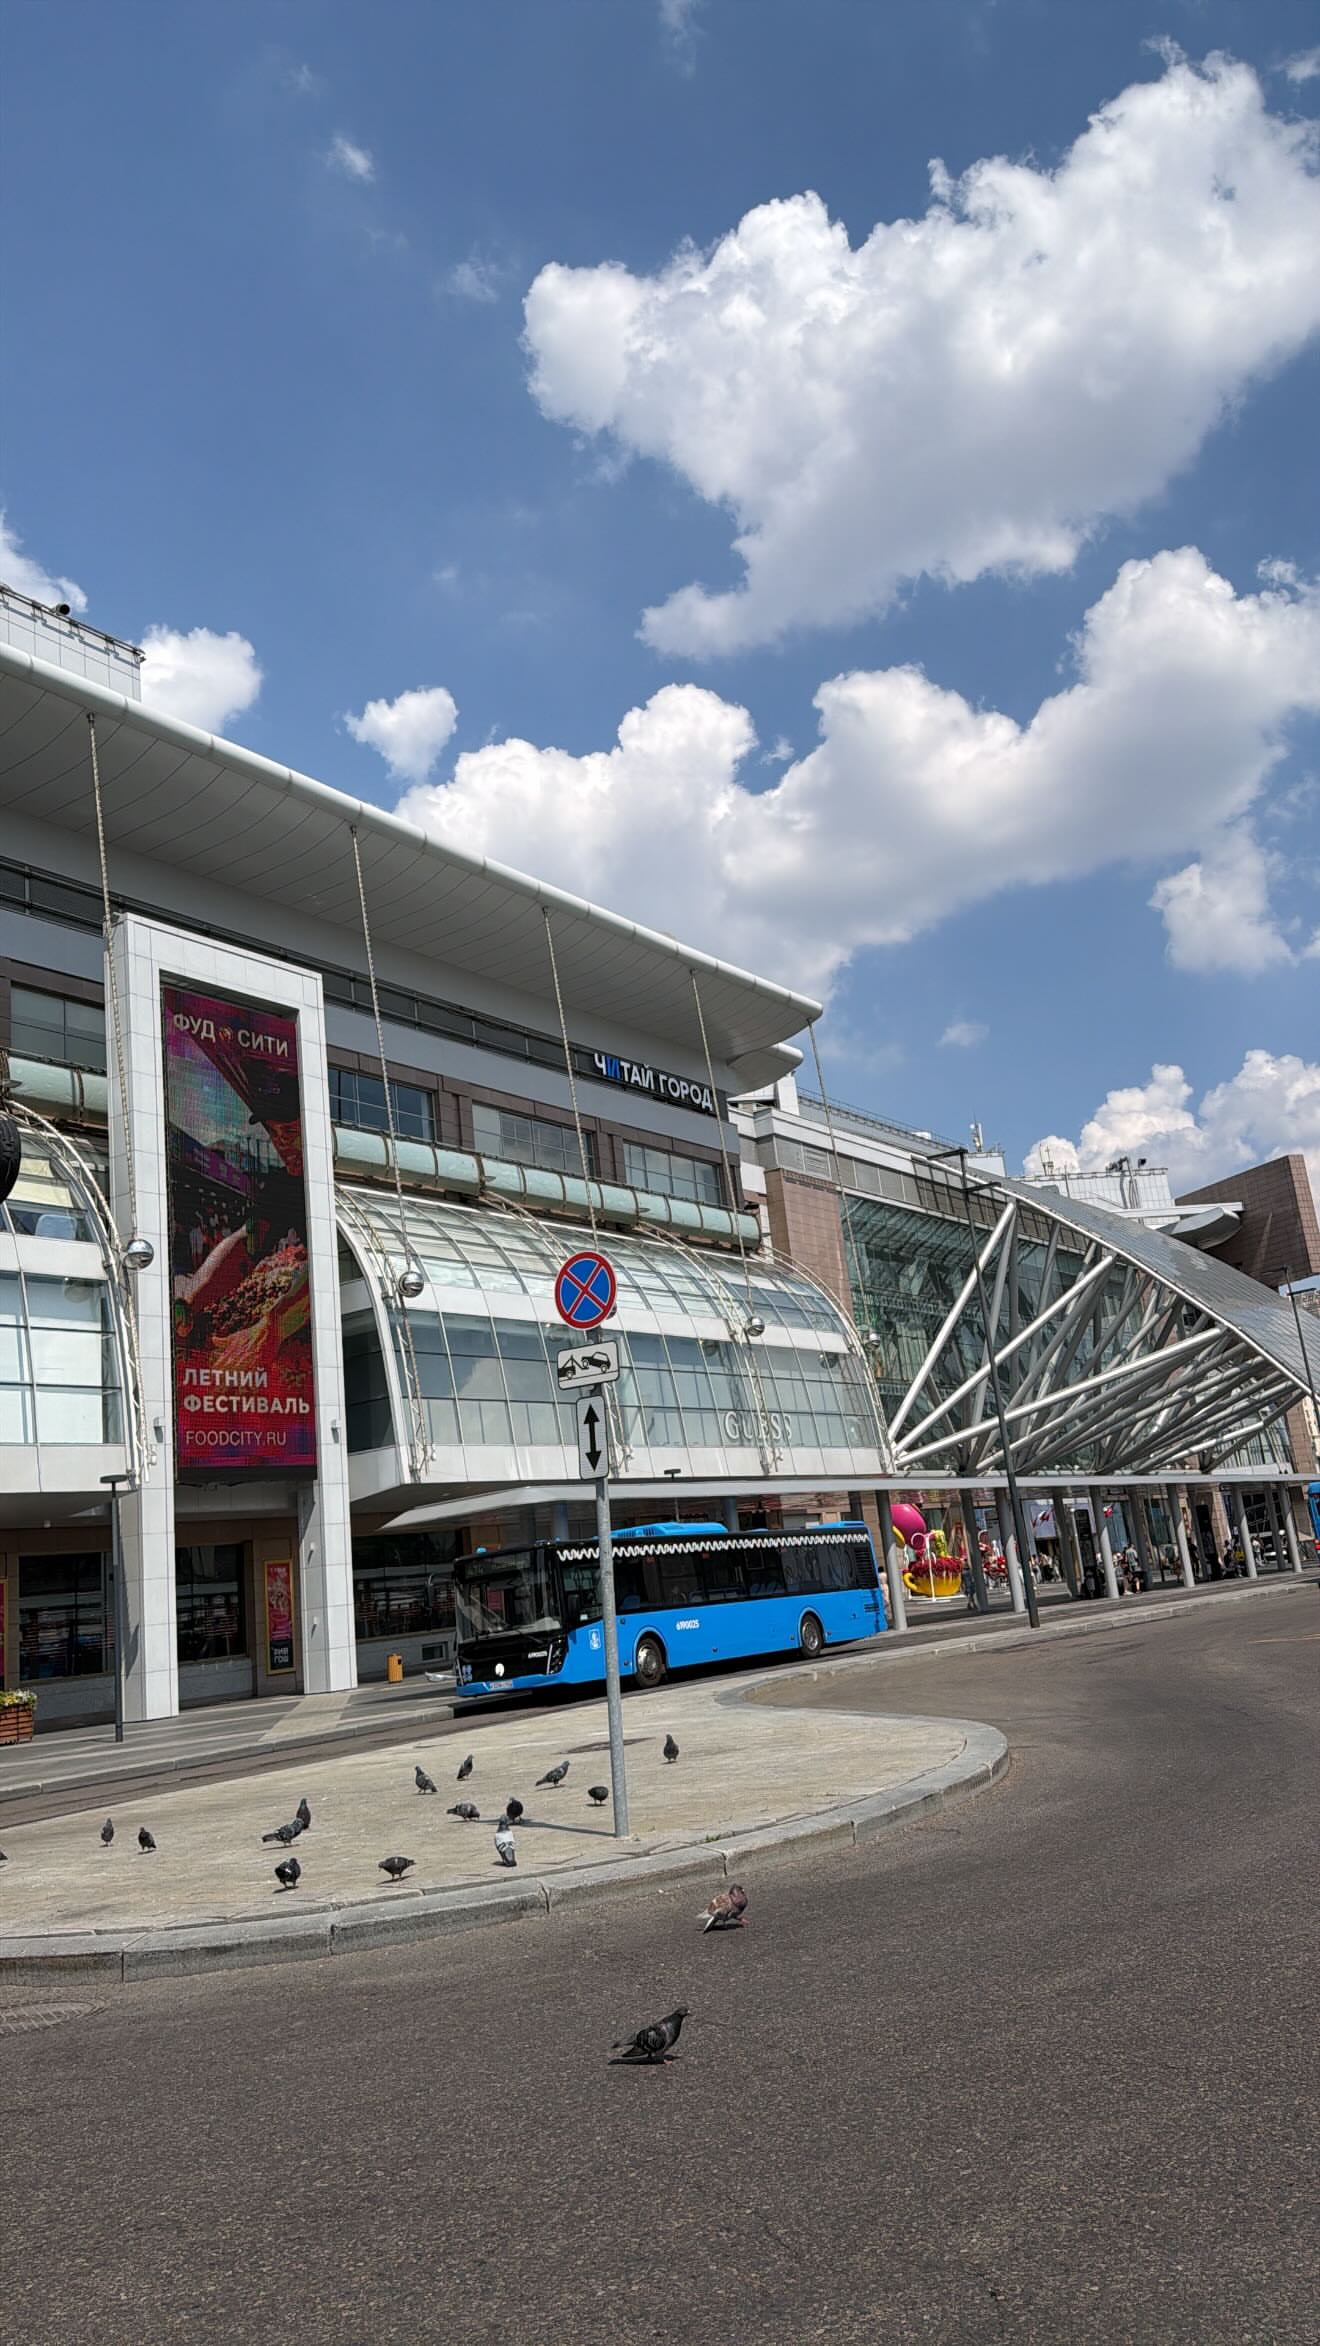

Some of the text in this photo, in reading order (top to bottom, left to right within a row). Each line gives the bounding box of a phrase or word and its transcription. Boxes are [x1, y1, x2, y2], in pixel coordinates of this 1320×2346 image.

[173, 1013, 289, 1057] ФУД СИТИ
[594, 1052, 713, 1112] ЧИТАЙ ГОРОД
[183, 1367, 268, 1388] ЛЕТНИЙ
[183, 1394, 310, 1414] ФЕСТИВАЛЬ
[185, 1430, 287, 1446] FOODCITY.RU
